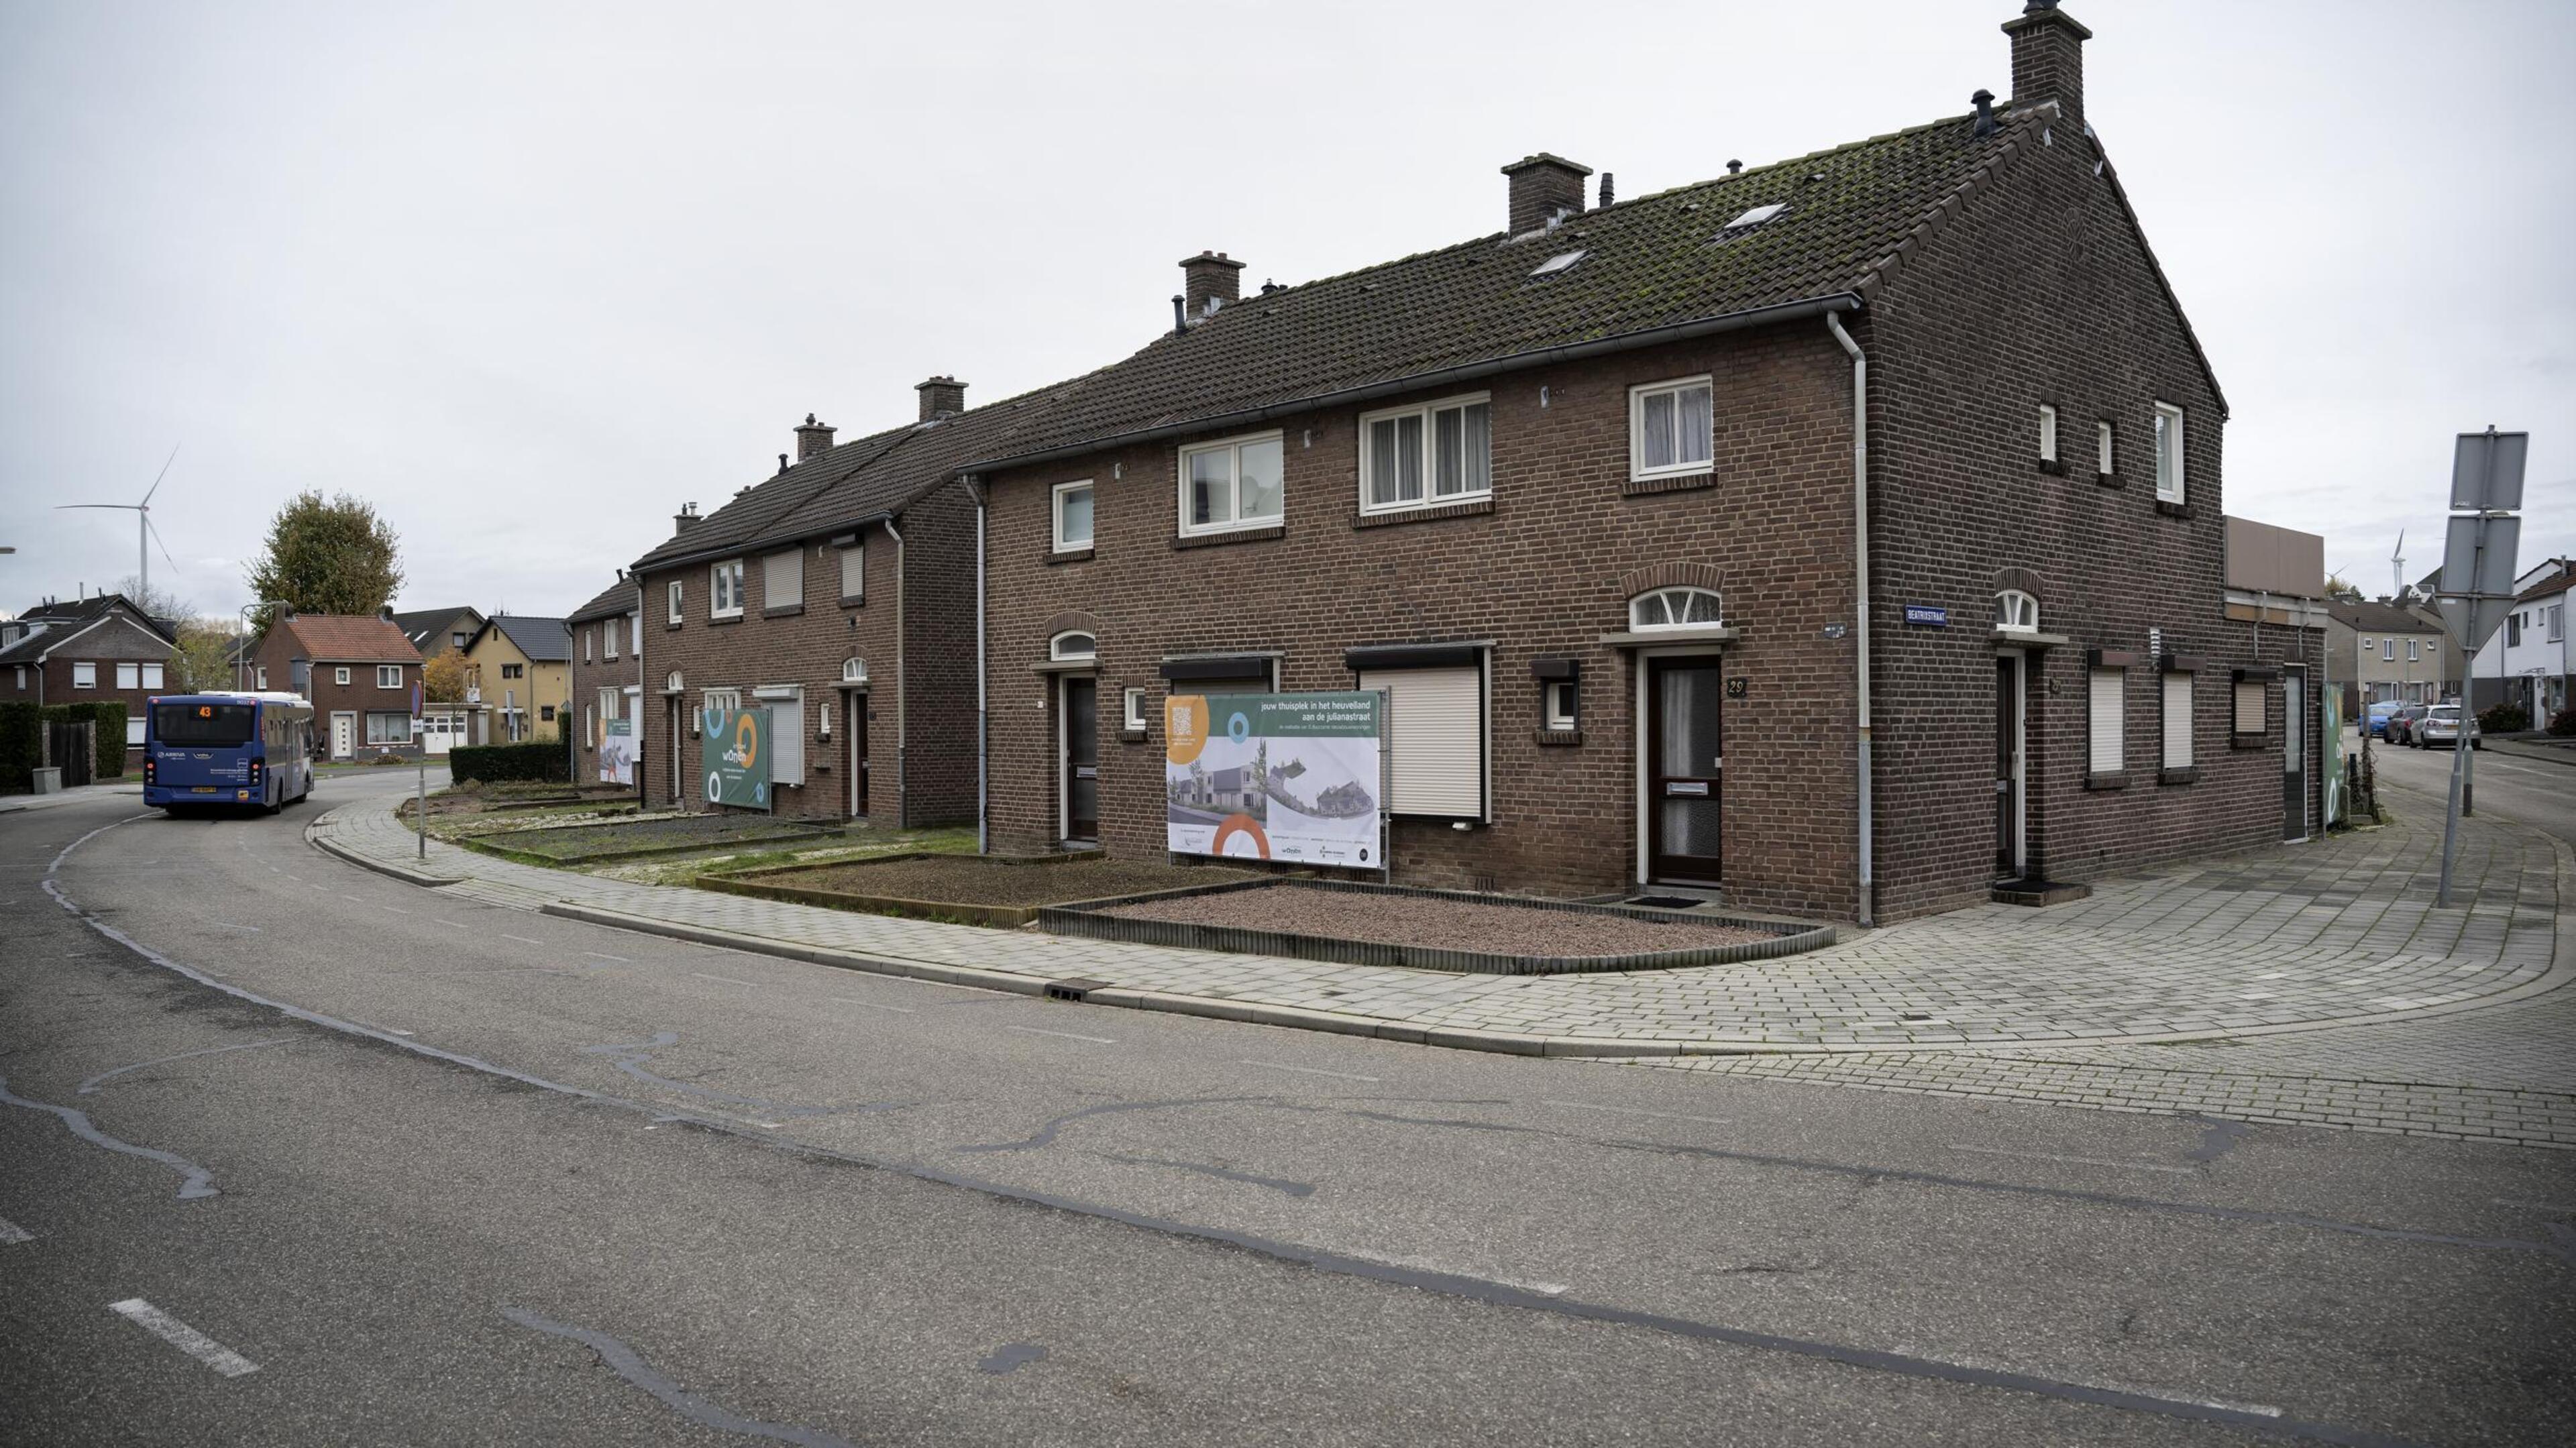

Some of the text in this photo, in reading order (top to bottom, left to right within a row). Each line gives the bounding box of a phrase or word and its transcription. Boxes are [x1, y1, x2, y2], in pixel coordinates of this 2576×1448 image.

[1908, 610, 1945, 622] BEATRIXSTRAAT
[1729, 681, 1743, 693] 29
[199, 706, 211, 717] 43
[1261, 702, 1277, 712] jouw
[1278, 702, 1309, 711] thuisplek
[1332, 700, 1371, 710] heuvelland
[1316, 712, 1325, 720] de
[1326, 712, 1371, 722] julianastraat
[722, 749, 747, 763] wonen
